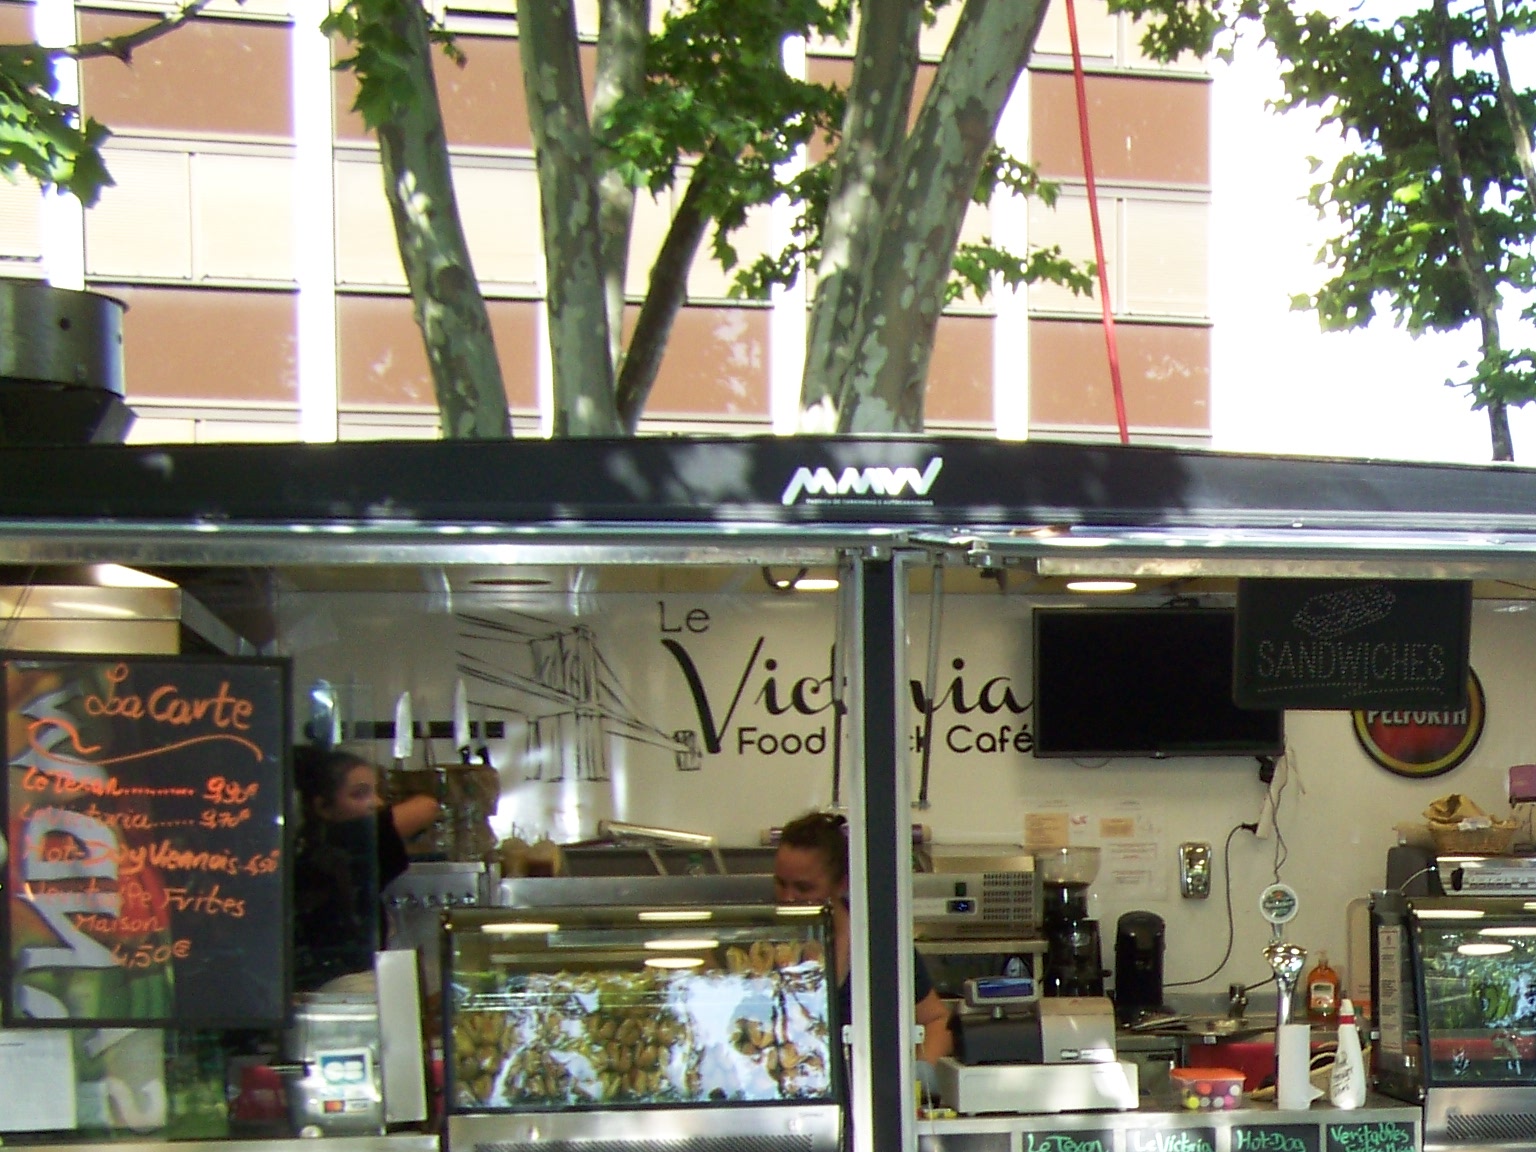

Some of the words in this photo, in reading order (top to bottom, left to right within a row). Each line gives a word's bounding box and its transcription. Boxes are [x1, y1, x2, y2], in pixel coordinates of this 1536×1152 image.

[659, 601, 710, 633] Le
[1257, 640, 1445, 682] SANDWICHES
[84, 663, 144, 719] La
[150, 681, 254, 730] Carte
[738, 726, 827, 755] Food
[946, 724, 1034, 754] Café
[161, 884, 247, 919] Frites
[1134, 1130, 1156, 1152] Le
